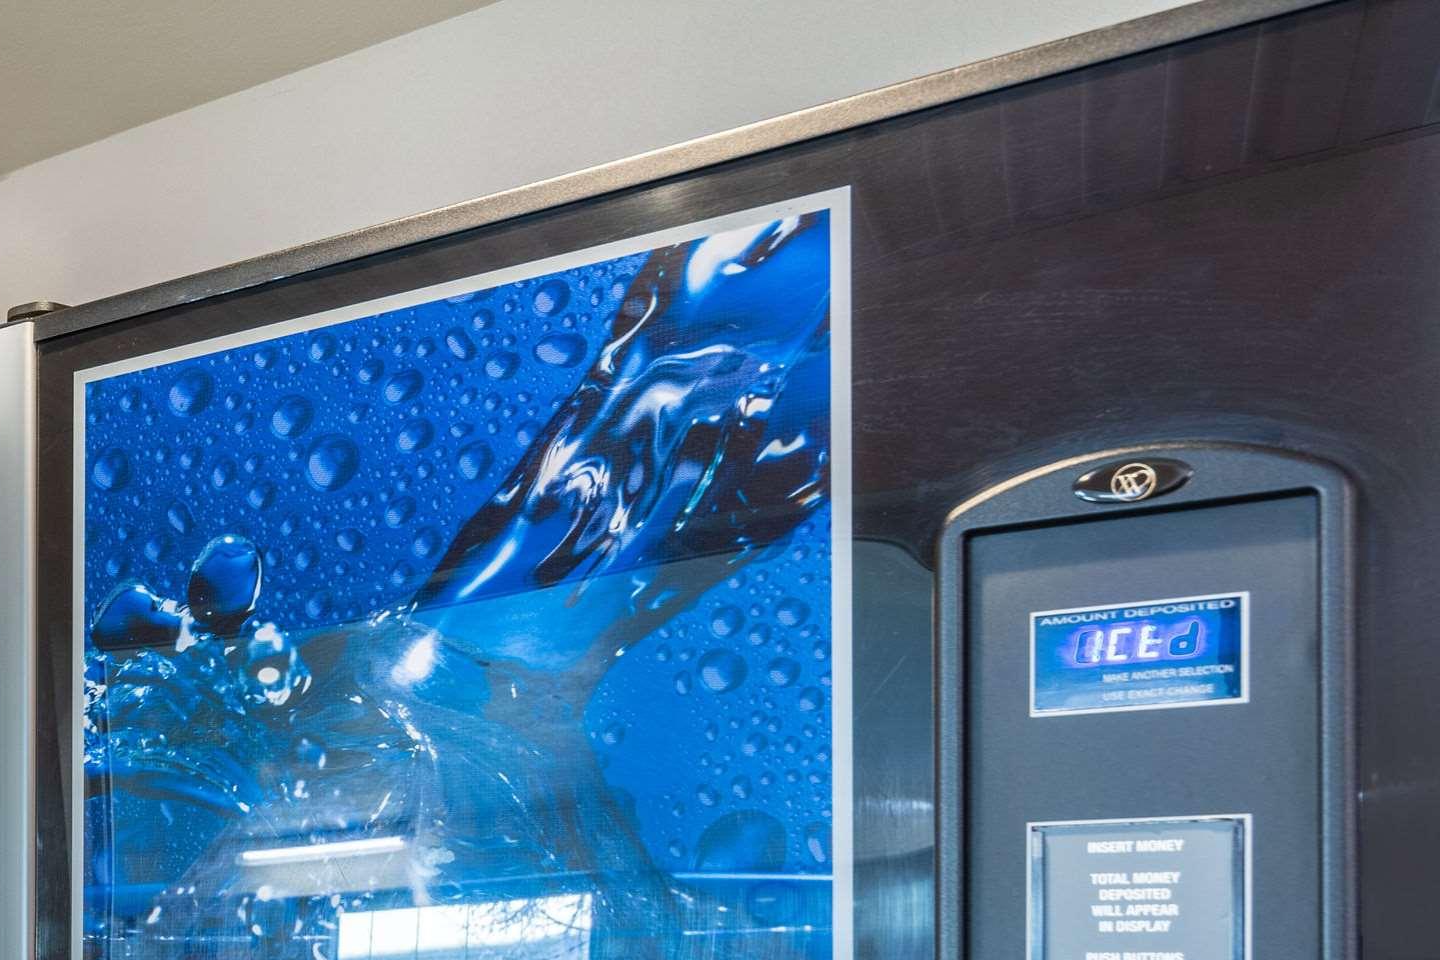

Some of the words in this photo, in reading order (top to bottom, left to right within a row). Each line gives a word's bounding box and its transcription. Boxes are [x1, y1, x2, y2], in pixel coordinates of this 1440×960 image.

[1040, 611, 1121, 626] AMOUNT
[1124, 599, 1235, 618] DEPOSITED
[1102, 673, 1129, 683] MAKE
[1131, 669, 1177, 681] ANOTHER
[1178, 664, 1234, 678] SELECTION
[1087, 840, 1133, 853] INSERT
[1136, 839, 1184, 852] MONEY
[1090, 873, 1130, 885] TOTAL
[1132, 871, 1181, 884] MONEY
[1099, 888, 1171, 901] DEPOSITED
[1091, 905, 1125, 916] WILL
[1126, 904, 1178, 916] APPEAR
[1099, 921, 1114, 932] IN
[1115, 920, 1171, 932] DISPLAY
